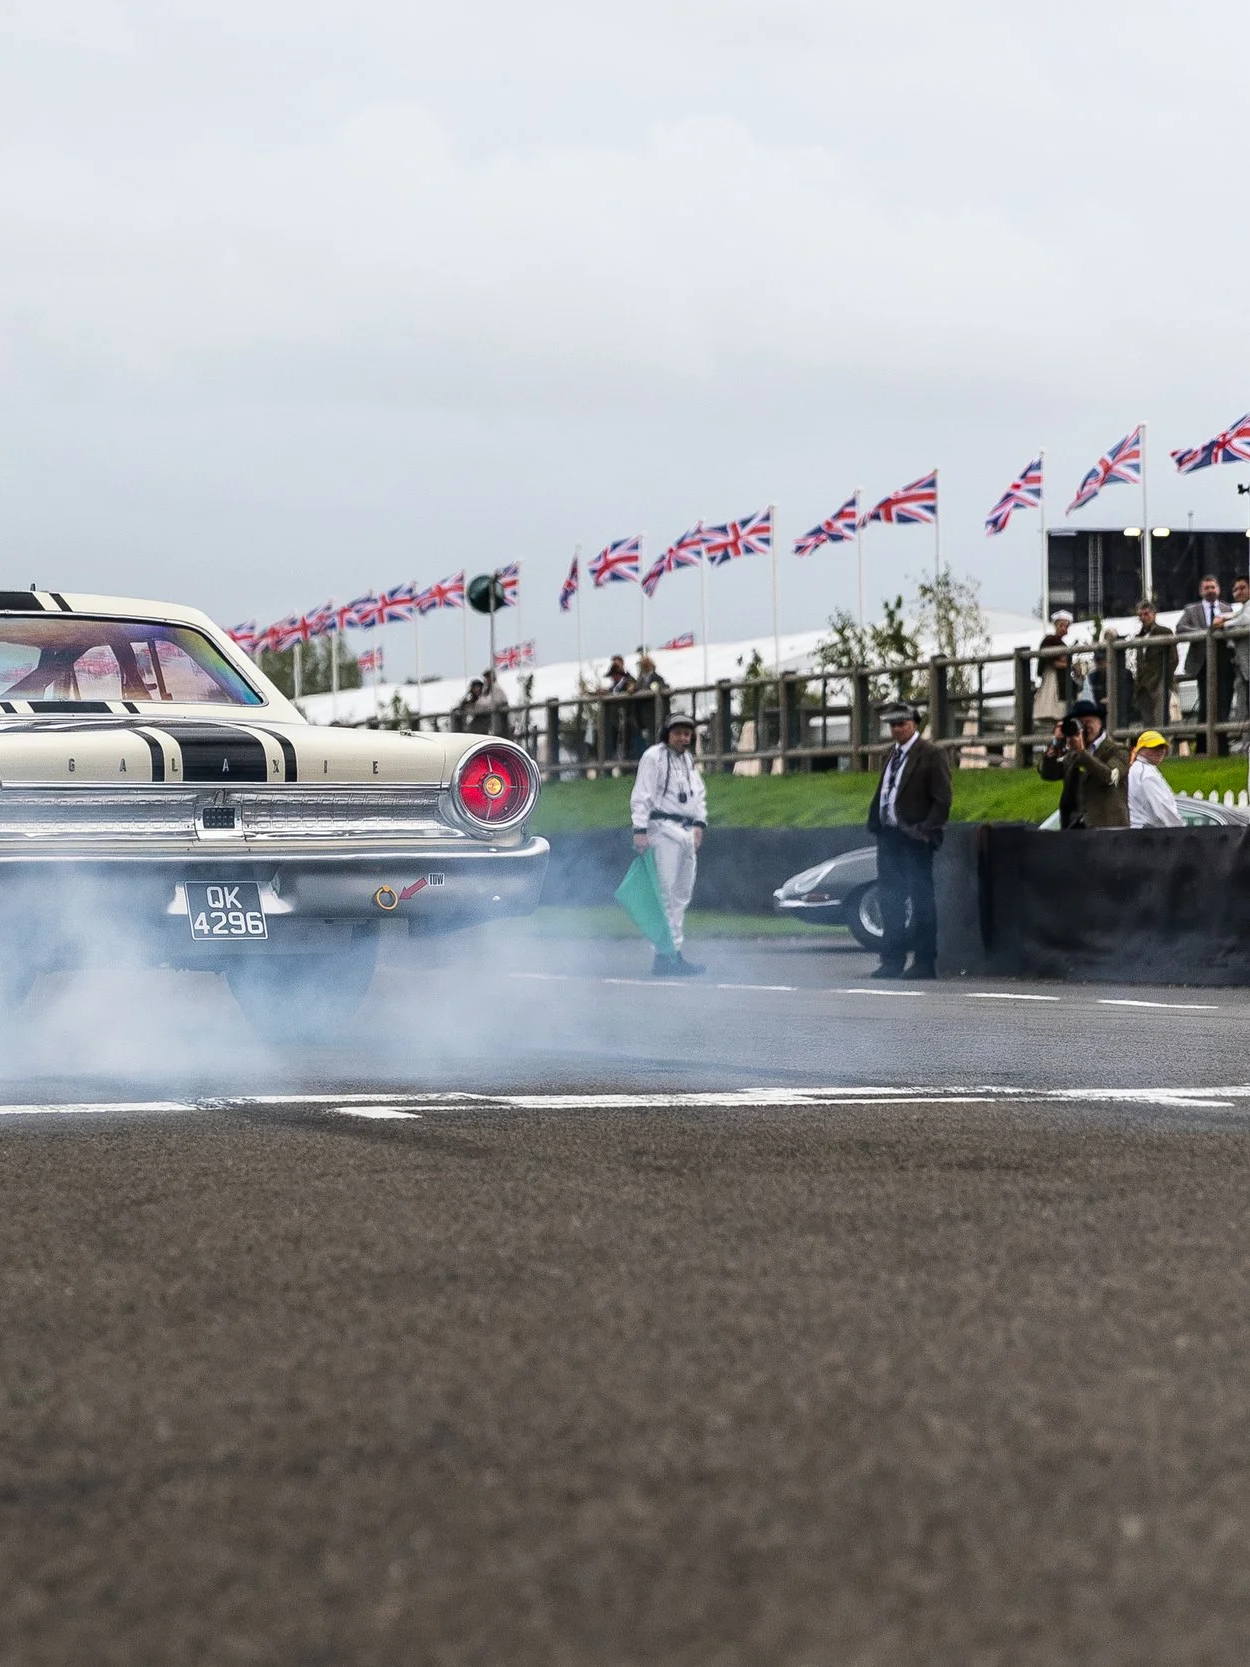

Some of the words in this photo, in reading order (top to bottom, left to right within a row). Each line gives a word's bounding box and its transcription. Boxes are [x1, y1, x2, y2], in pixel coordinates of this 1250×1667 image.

[67, 757, 379, 774] GALAXIE
[429, 873, 444, 885] TOW
[206, 886, 243, 909] QK
[193, 911, 265, 935] 4296
